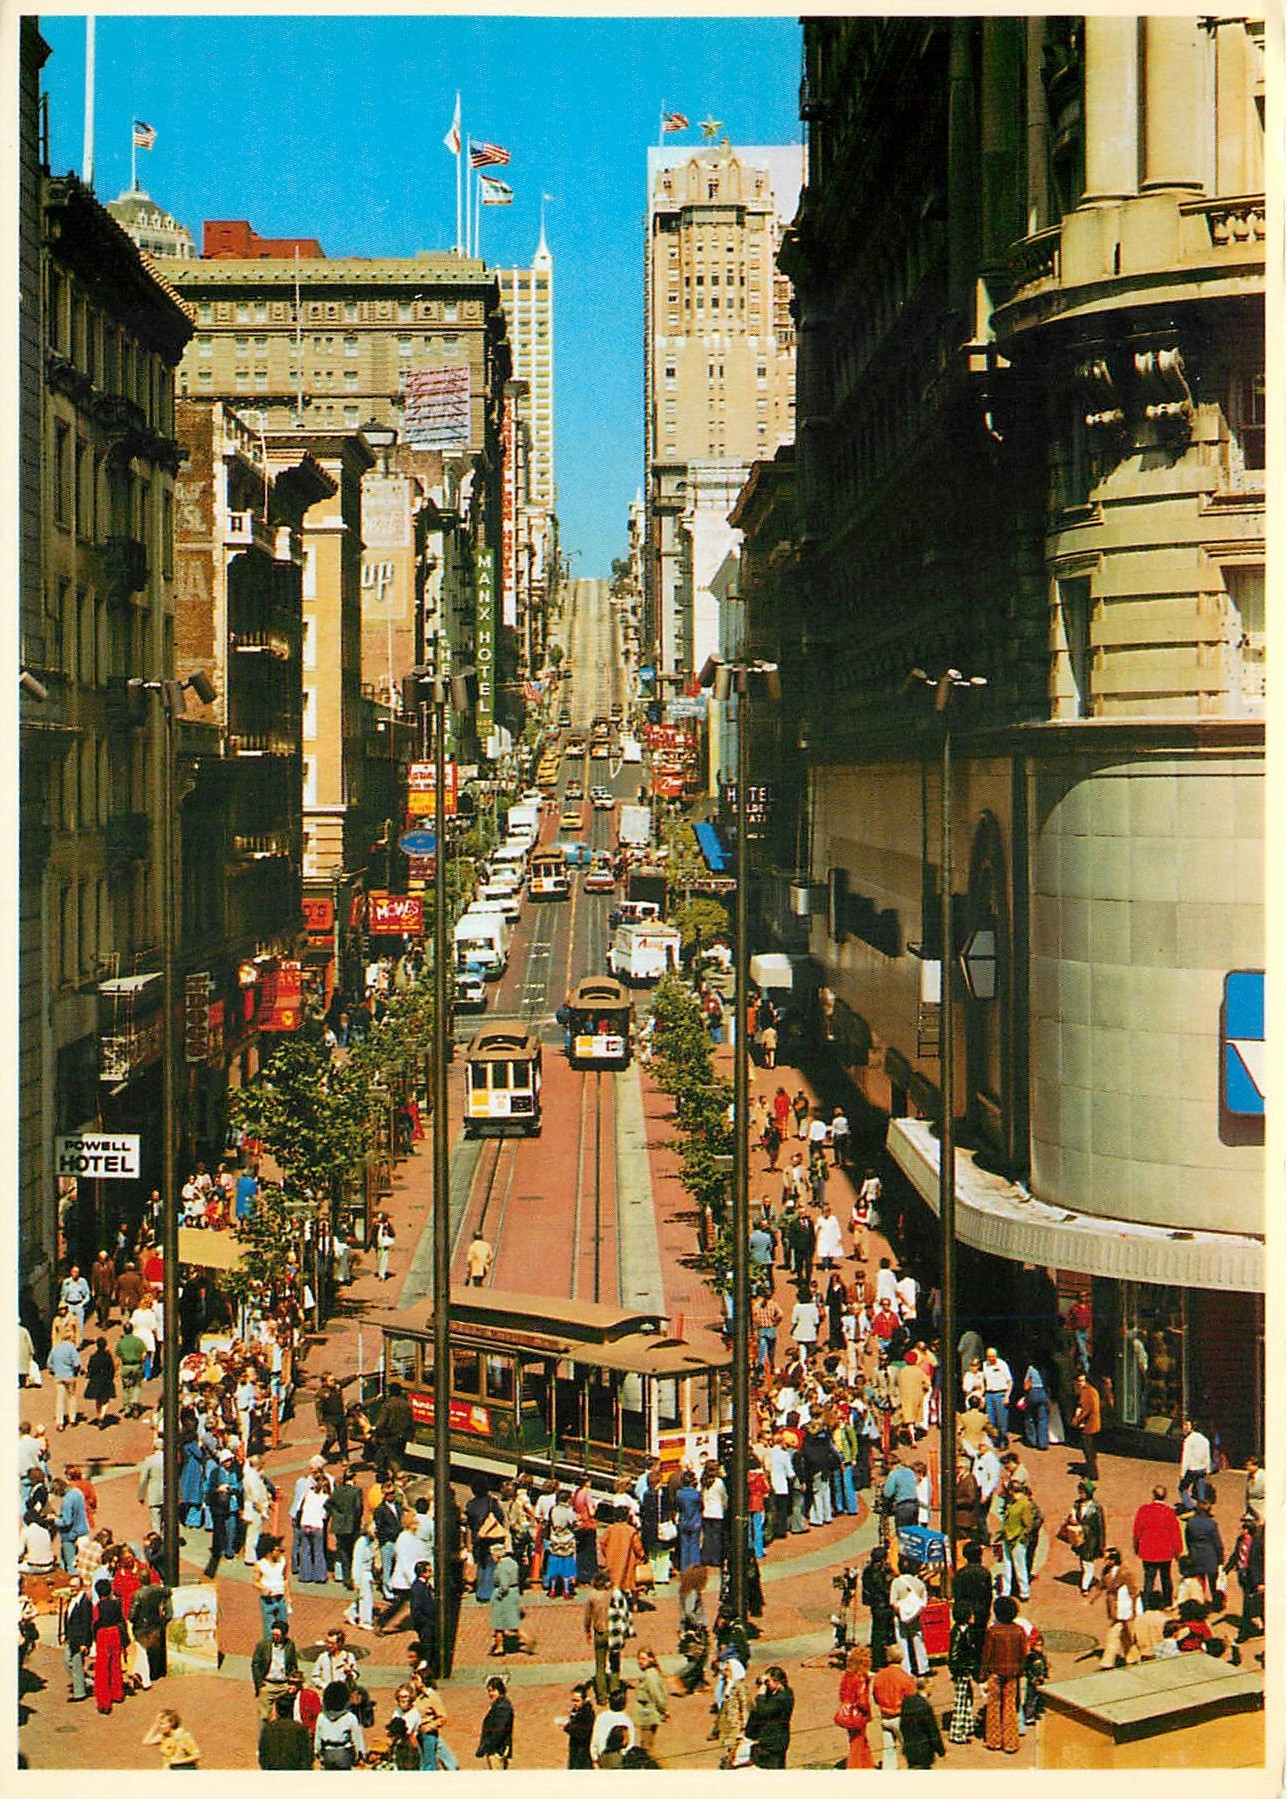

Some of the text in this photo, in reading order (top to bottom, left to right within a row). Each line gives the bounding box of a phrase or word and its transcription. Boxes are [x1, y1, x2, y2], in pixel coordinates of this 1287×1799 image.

[501, 529, 512, 591] HOTEL
[478, 555, 492, 621] MANX
[478, 631, 492, 713] HOTEL
[726, 786, 775, 802] HTEL
[60, 1155, 134, 1173] HOTEL
[65, 1140, 131, 1151] POWELL
